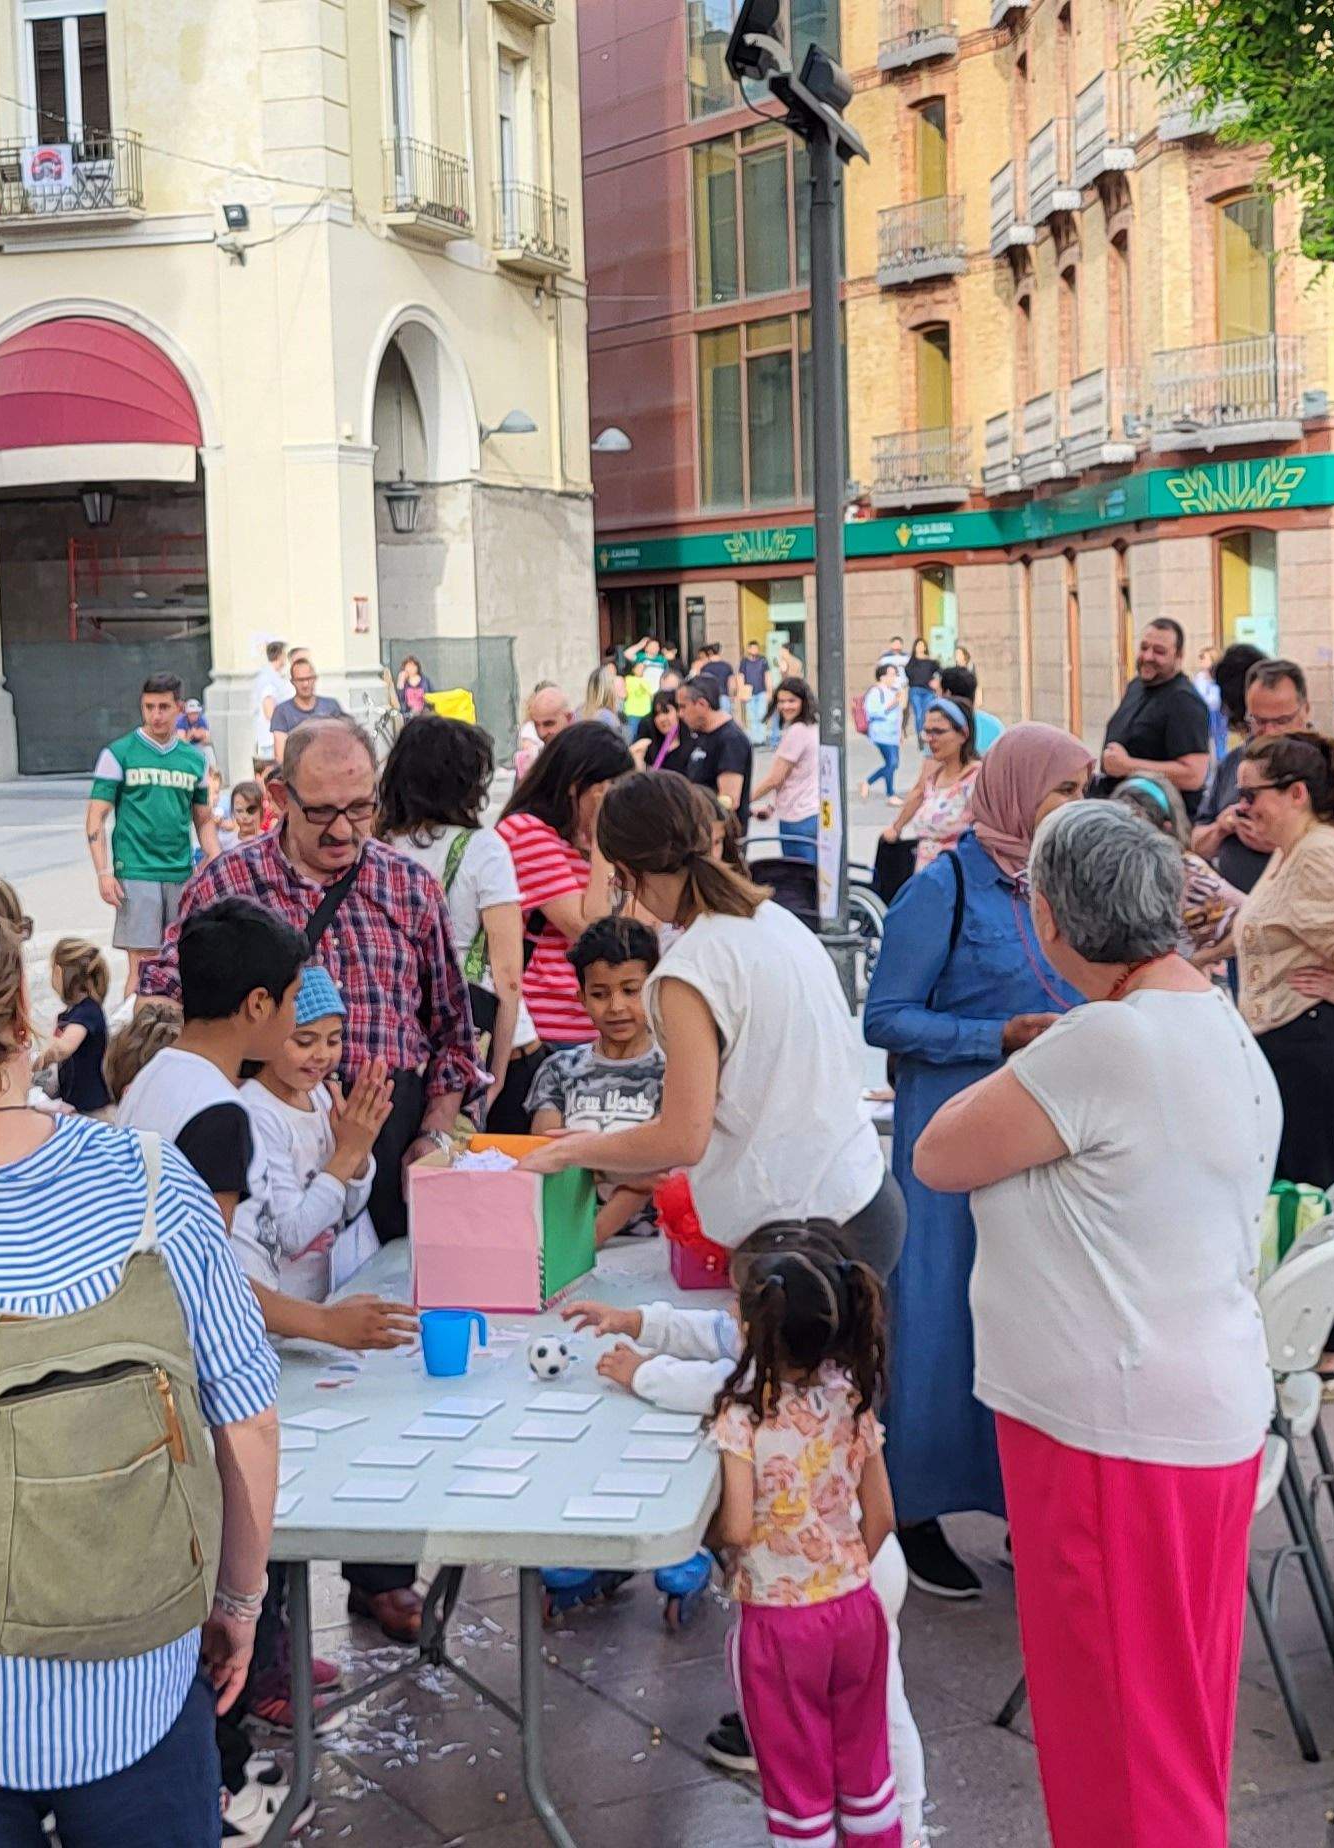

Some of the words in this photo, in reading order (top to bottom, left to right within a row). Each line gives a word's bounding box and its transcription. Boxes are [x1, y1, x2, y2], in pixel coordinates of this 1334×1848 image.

[125, 767, 198, 792] DETROIT
[564, 1088, 601, 1117] New
[604, 1089, 650, 1124] York
